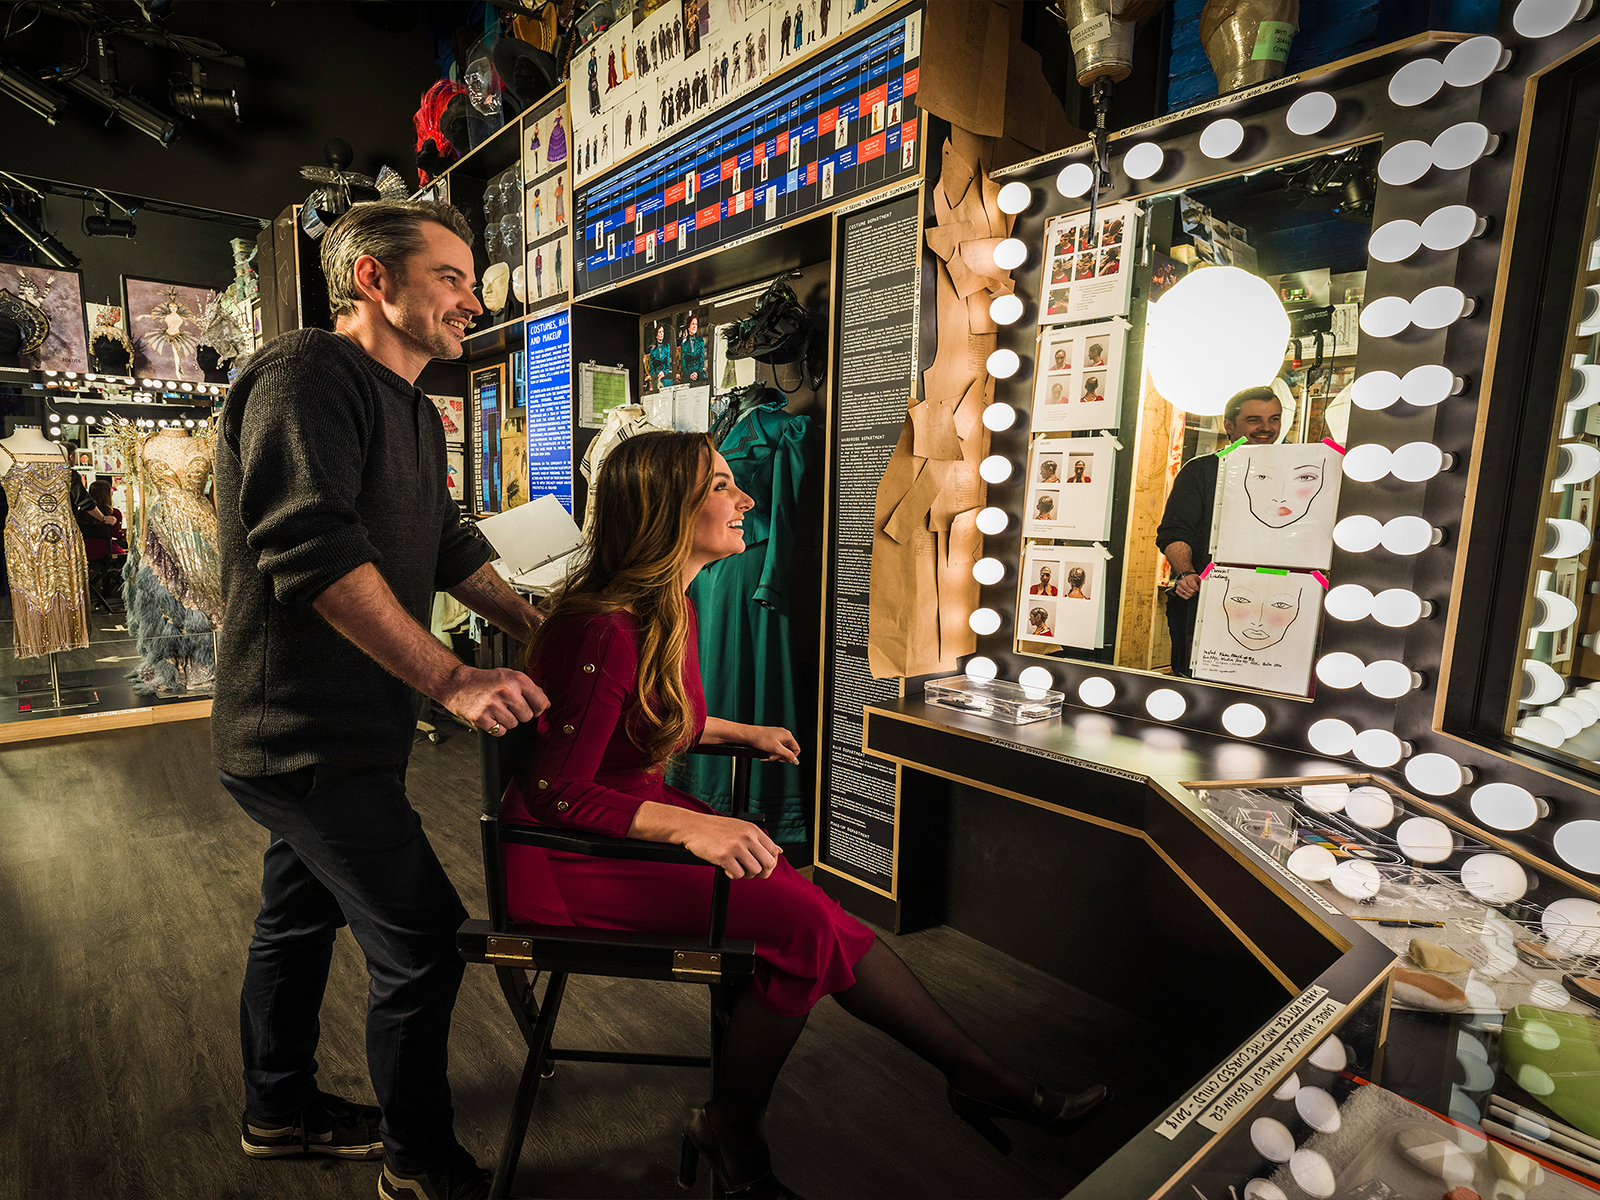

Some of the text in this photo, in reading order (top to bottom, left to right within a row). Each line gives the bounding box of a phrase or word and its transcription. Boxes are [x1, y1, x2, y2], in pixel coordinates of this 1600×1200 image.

[1082, 22, 1104, 35] LUPONE
[1076, 32, 1096, 44] JOANNE
[1124, 120, 1156, 135] CAMPBELL
[1158, 114, 1179, 124] YOUNG
[1186, 100, 1222, 116] ASSOCIATES
[848, 212, 893, 231] COSTUME DEPARTMENT
[530, 320, 558, 336] COSTUMES,
[530, 330, 562, 346] AND MAKEUP
[842, 748, 866, 758] DEPARTMENT
[992, 738, 1023, 751] CAMPBELL
[1025, 747, 1045, 756] YOUNG
[1116, 771, 1145, 783] MAKEUP
[847, 827, 870, 839] DEPARTMENT
[1275, 1004, 1305, 1028] POTTER
[1312, 1004, 1337, 1025] CAROLE
[1262, 1027, 1280, 1042] AND
[1246, 1040, 1266, 1056] THE
[1217, 1052, 1250, 1083] CURSED
[1193, 1081, 1220, 1109] CHILD"
[1209, 1082, 1254, 1122] DESIGNER
[1166, 1107, 1192, 1130] 2018
[1511, 1132, 1537, 1145] COSMETICS
